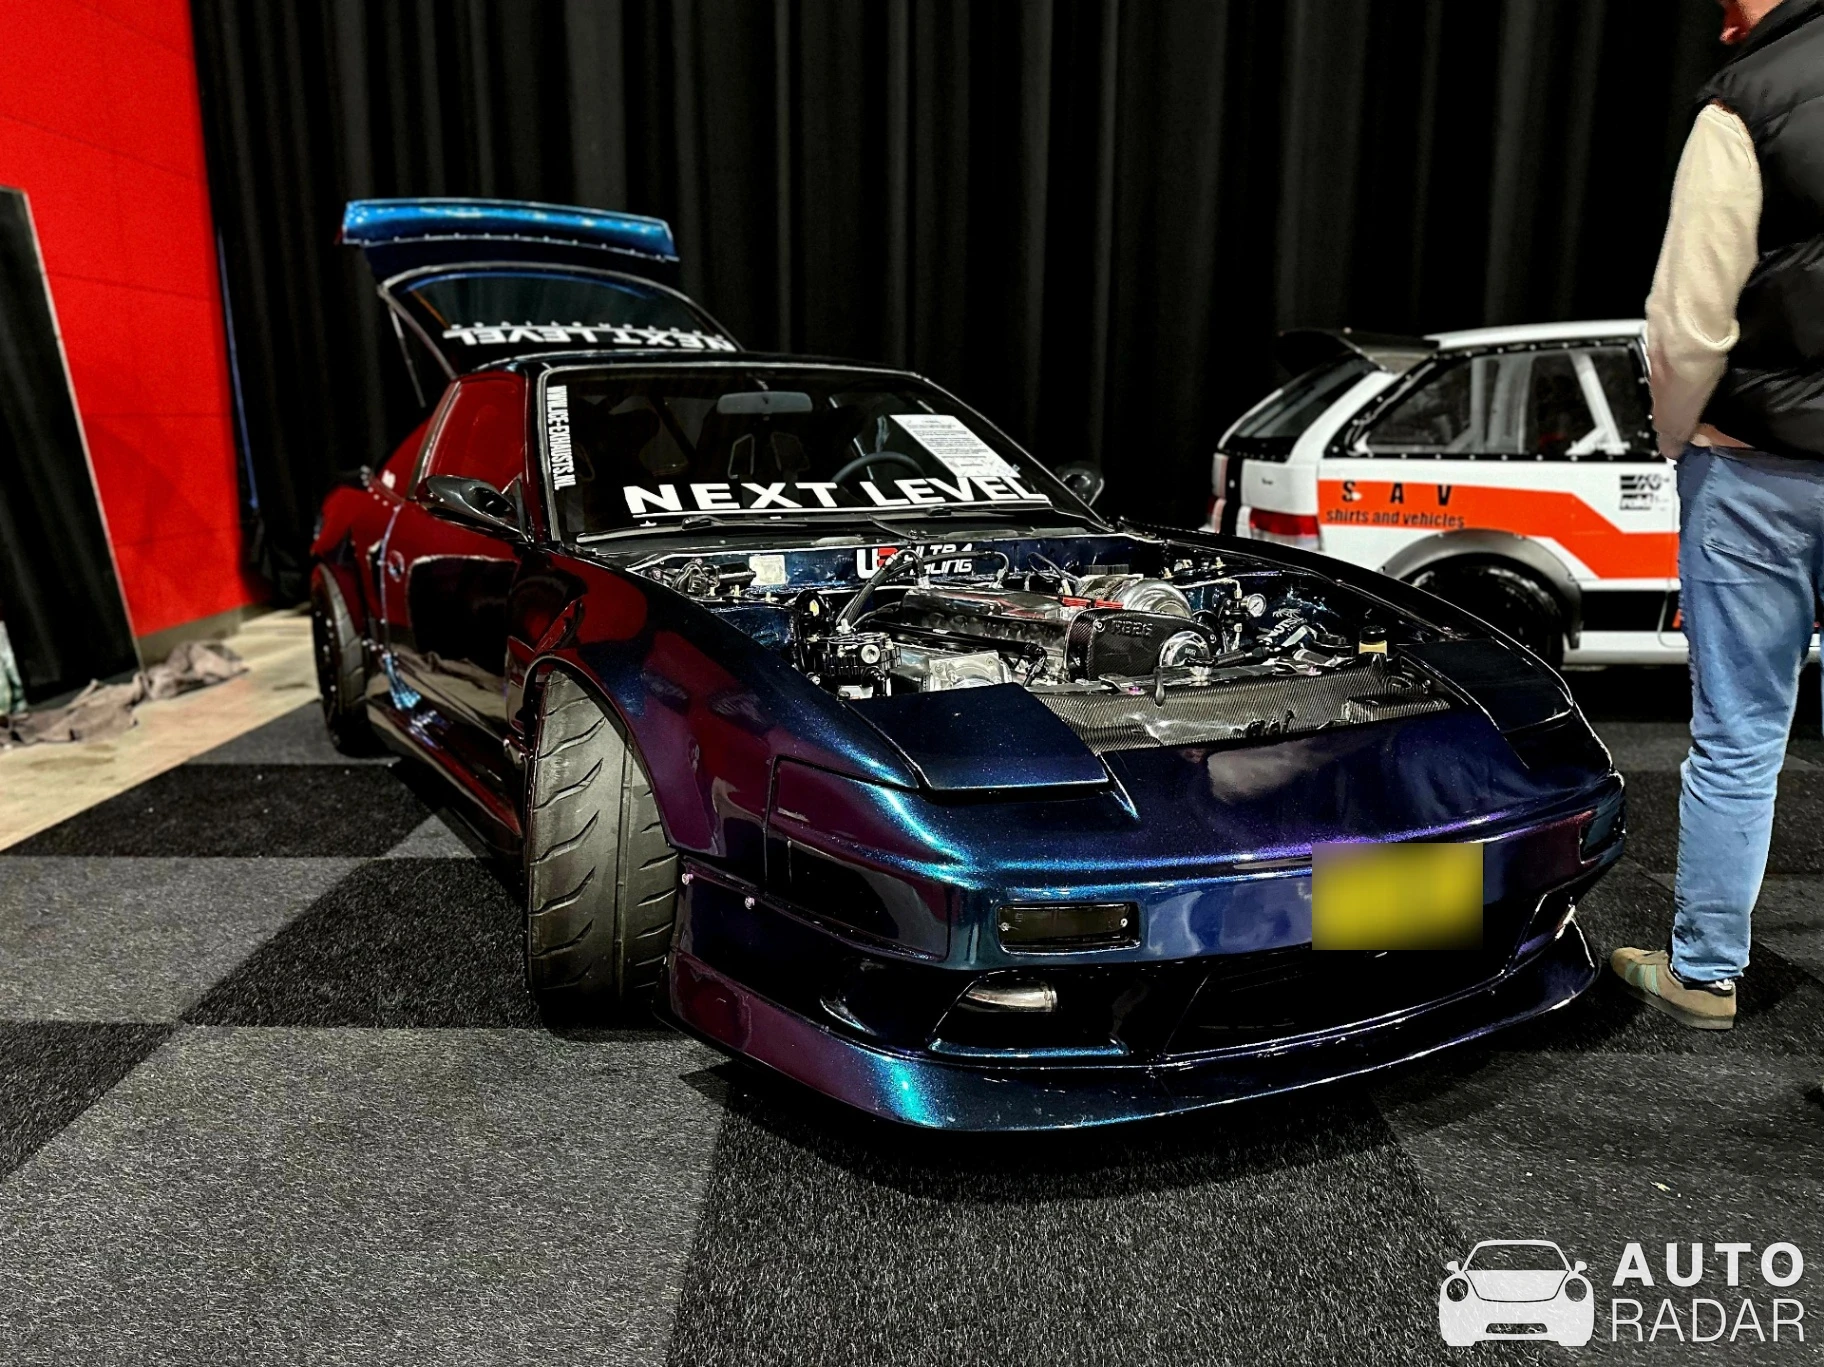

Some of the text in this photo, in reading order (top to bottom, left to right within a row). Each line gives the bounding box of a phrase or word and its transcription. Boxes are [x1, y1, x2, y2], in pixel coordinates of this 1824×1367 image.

[443, 325, 738, 351] NEXT LEVEL
[622, 476, 1049, 514] NEXT LEVEL
[1326, 508, 1466, 529] shirts and vehicles
